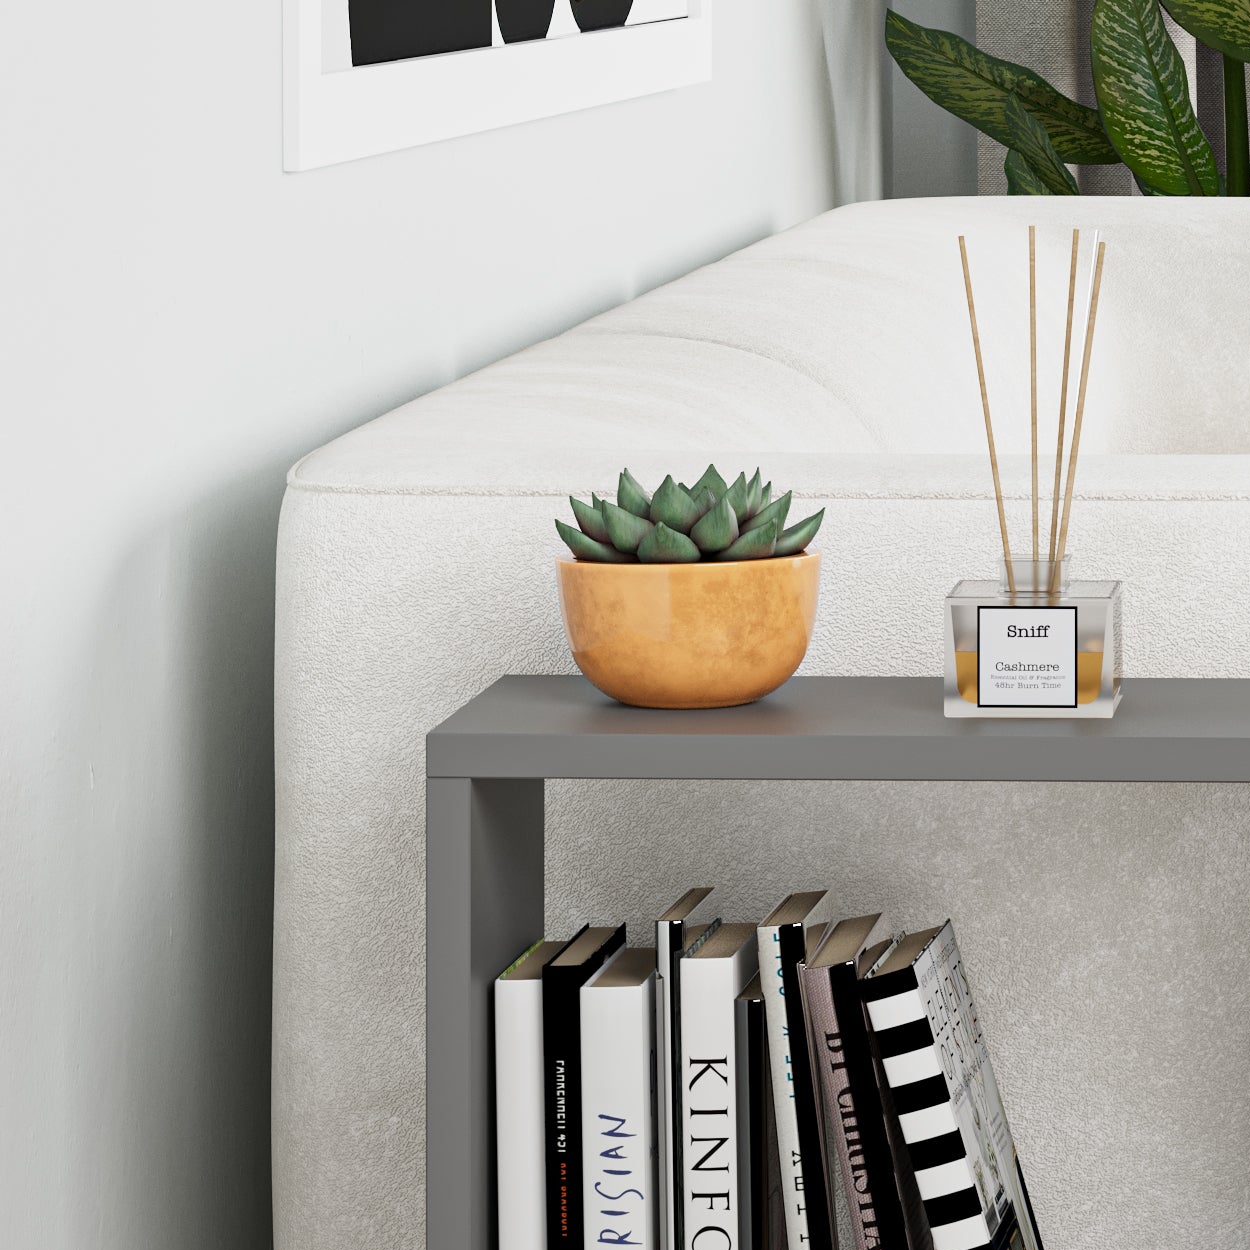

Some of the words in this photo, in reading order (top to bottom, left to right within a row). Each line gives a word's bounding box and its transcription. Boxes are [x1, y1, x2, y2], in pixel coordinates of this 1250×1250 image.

[1007, 624, 1050, 638] Sniff
[995, 662, 1060, 672] Cashmere
[1017, 682, 1039, 690] Burn
